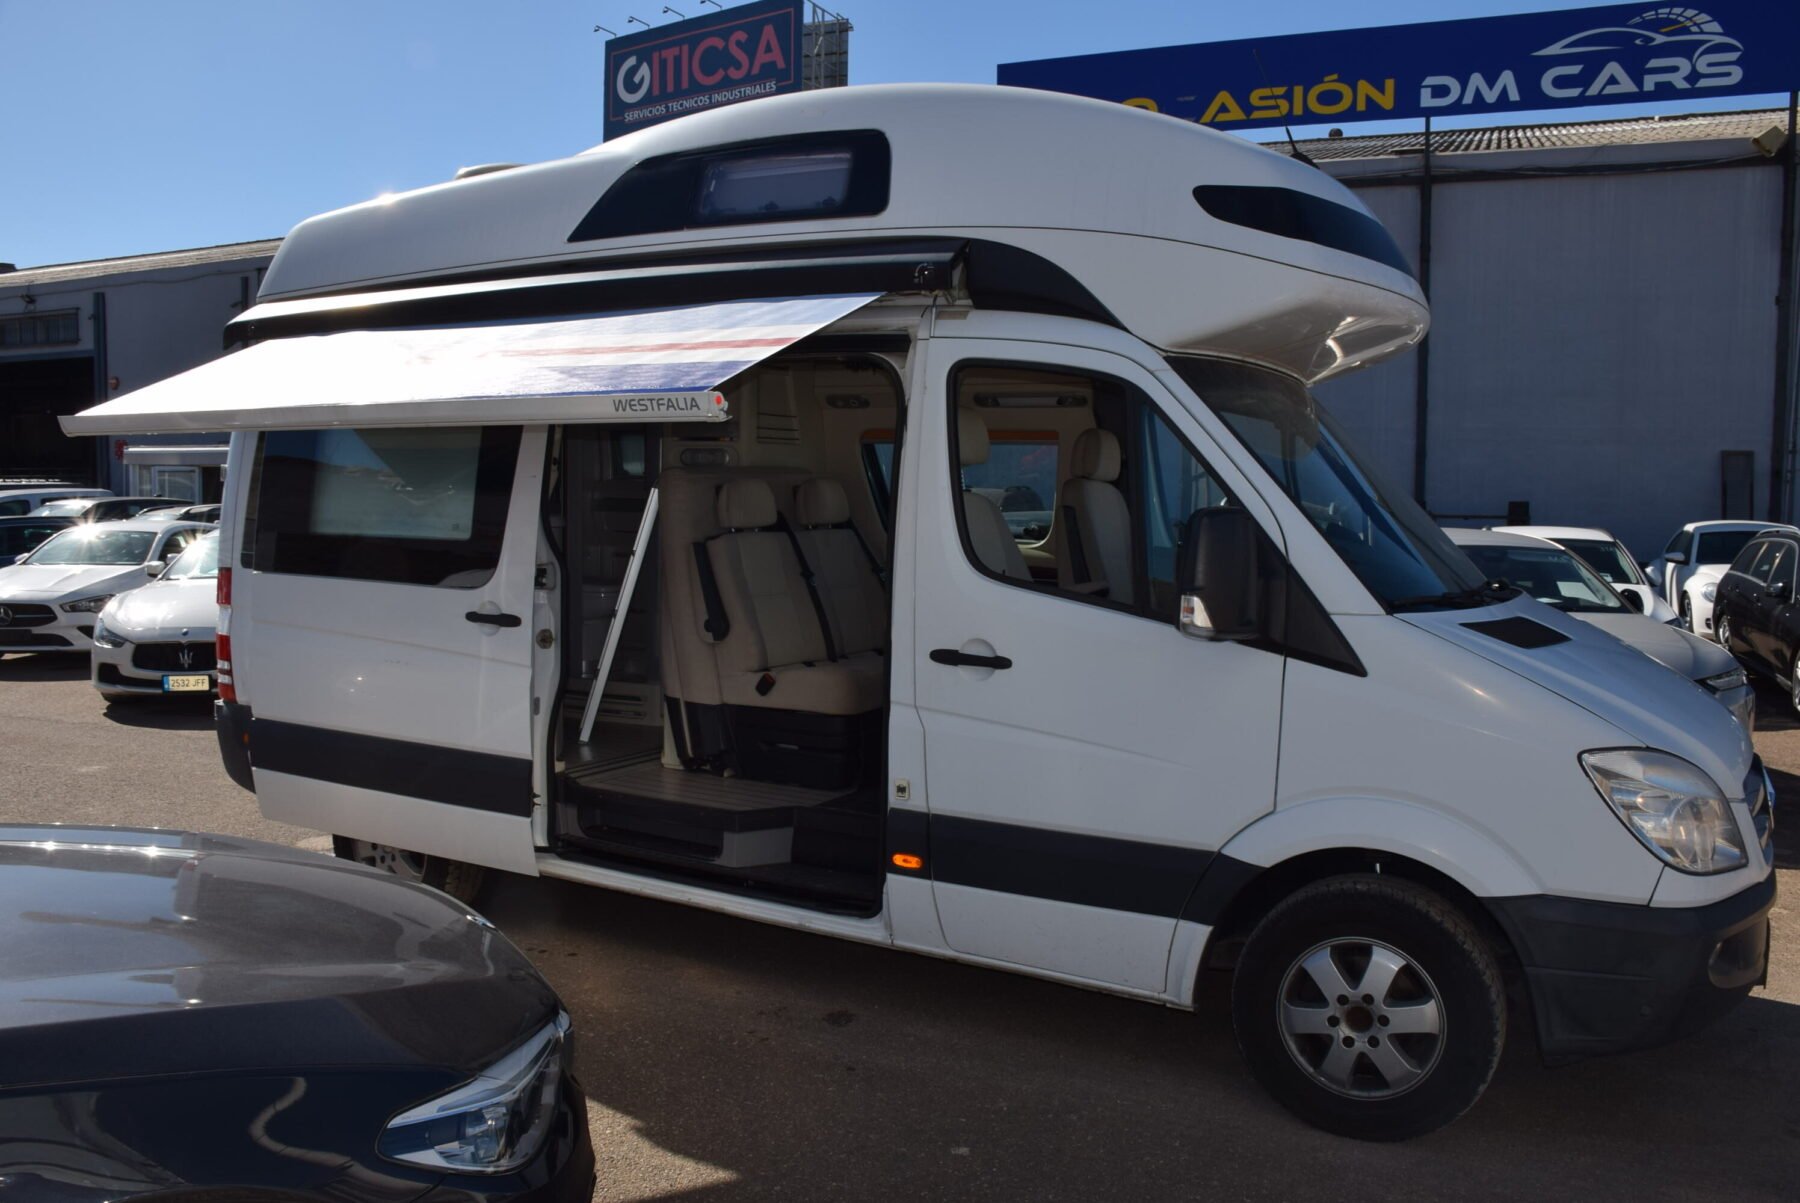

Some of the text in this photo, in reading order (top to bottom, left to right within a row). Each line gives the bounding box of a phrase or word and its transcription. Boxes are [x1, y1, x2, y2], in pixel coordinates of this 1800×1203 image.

[1419, 69, 1521, 108] DM
[1540, 50, 1744, 99] CARS
[624, 105, 667, 122] SERVICIOS
[711, 80, 777, 104] INDUSTRIALES
[612, 397, 701, 412] WESTFALIA
[171, 678, 206, 688] 2532 JFF
